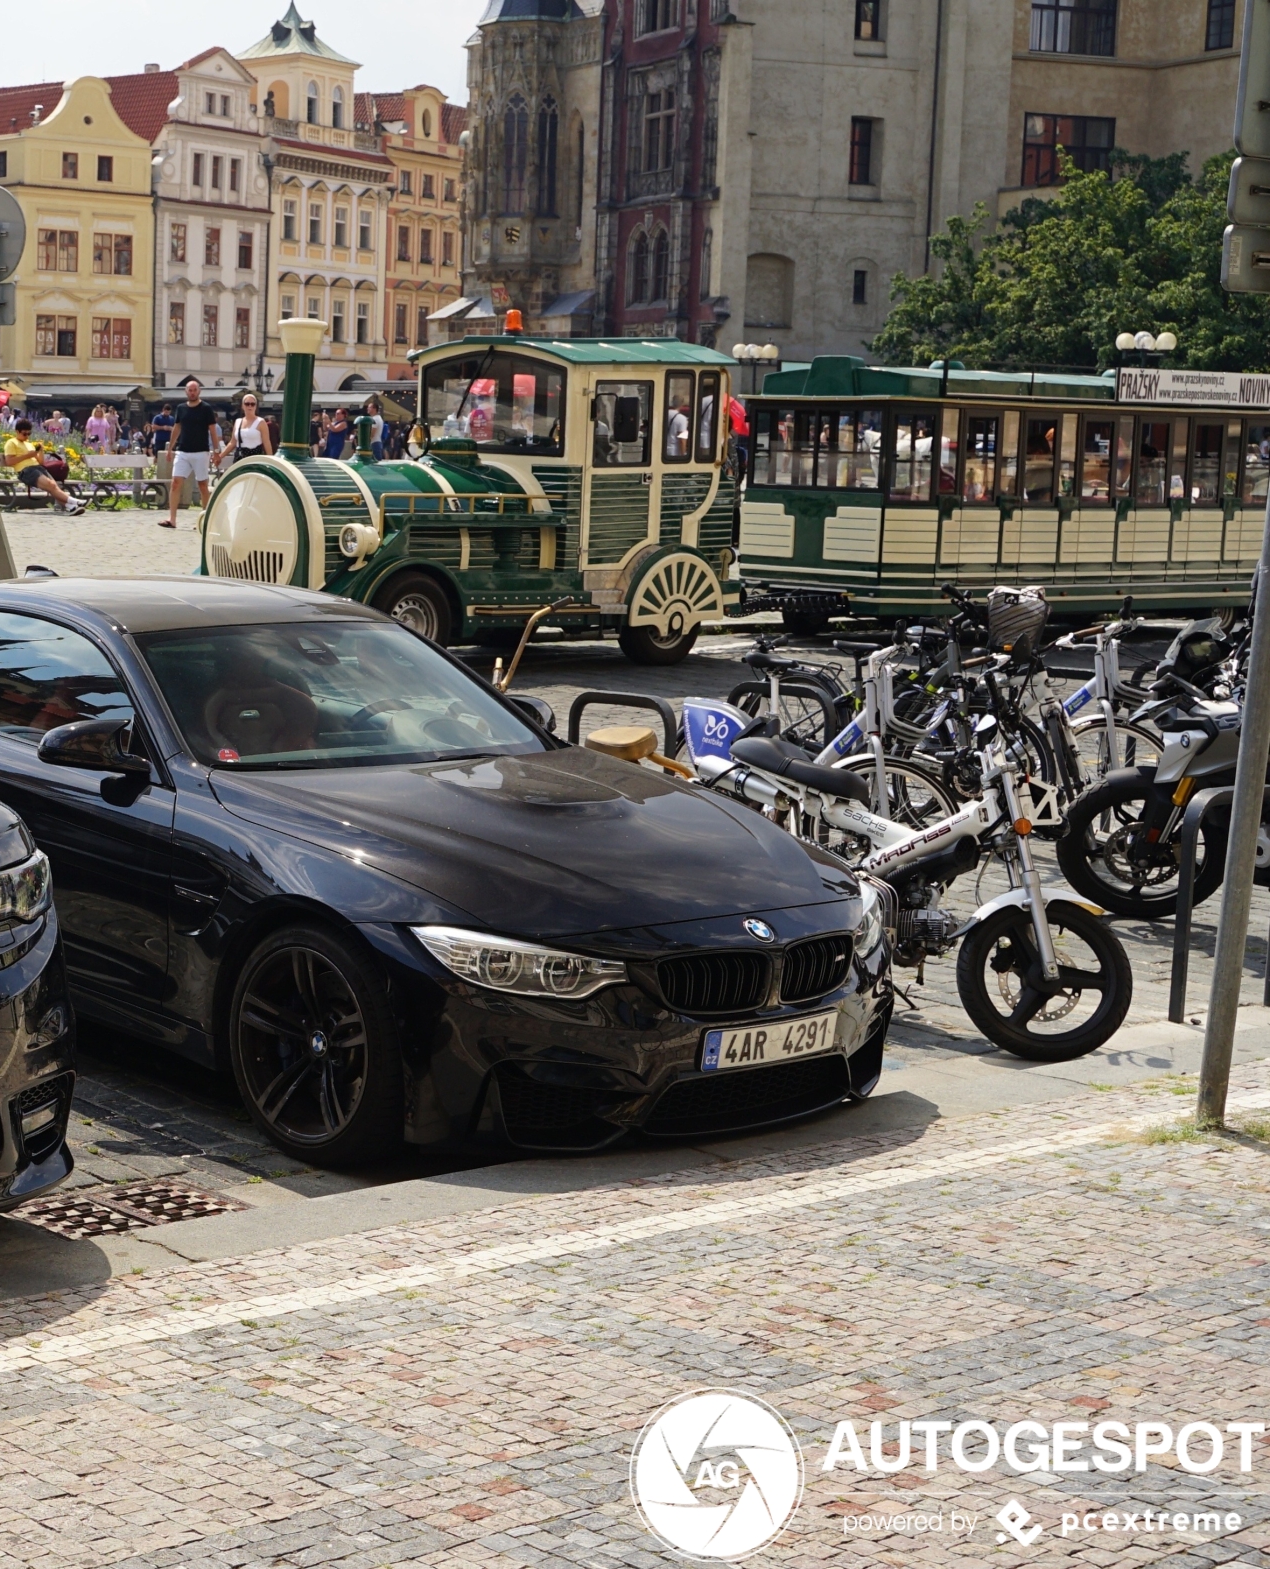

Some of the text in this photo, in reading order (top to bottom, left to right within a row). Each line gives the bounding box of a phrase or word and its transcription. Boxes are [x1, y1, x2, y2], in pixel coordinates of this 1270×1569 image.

[92, 334, 130, 345] CAFE
[1120, 370, 1160, 400] PRAŽSKÝ
[702, 737, 724, 748] nextbike
[866, 827, 884, 838] BIKES
[725, 1017, 828, 1063] 4AR 4291
[705, 1055, 717, 1065] CZ
